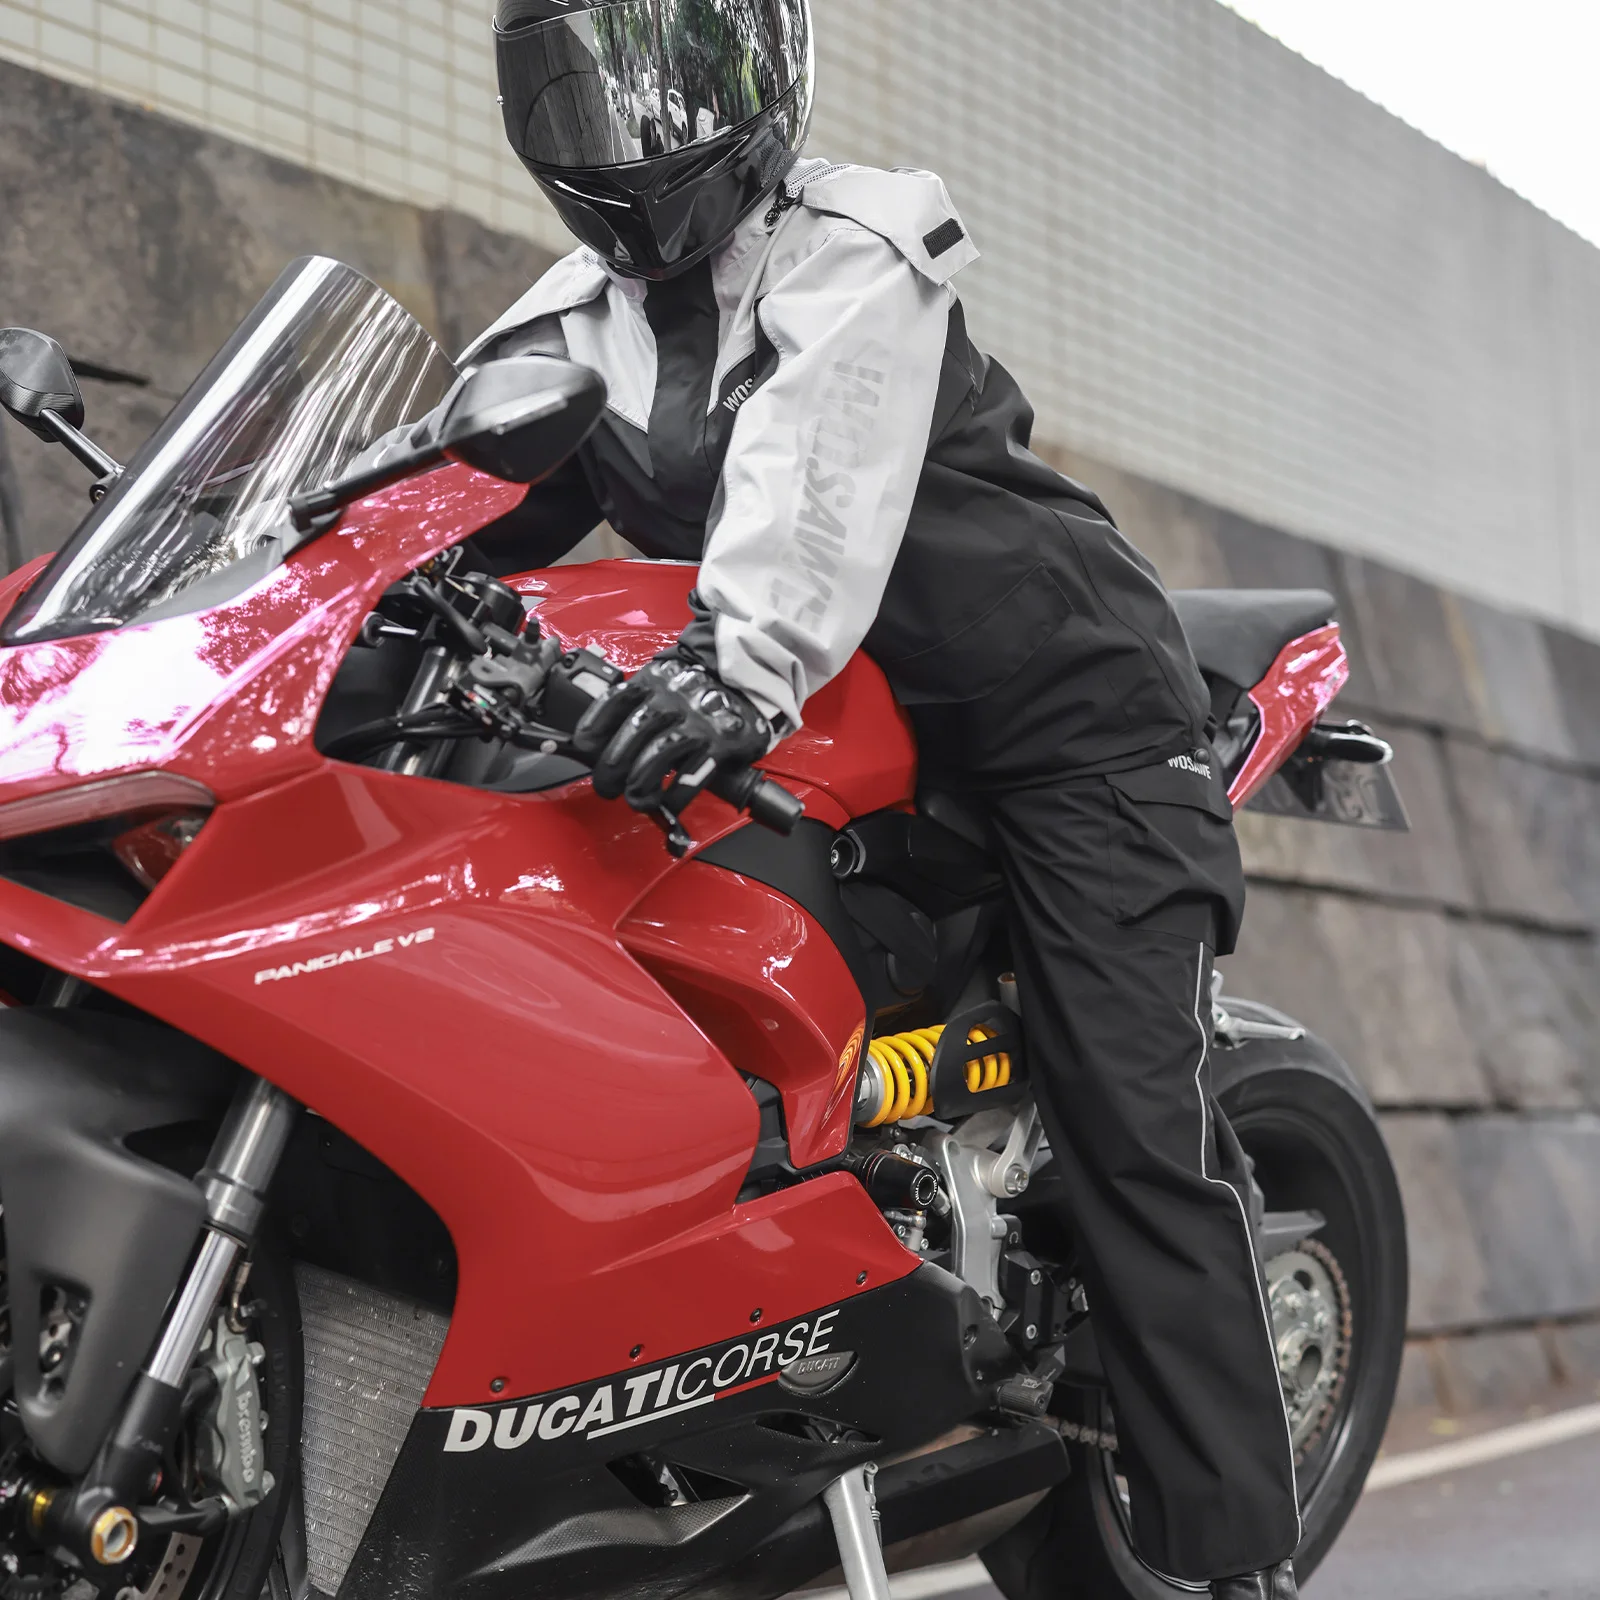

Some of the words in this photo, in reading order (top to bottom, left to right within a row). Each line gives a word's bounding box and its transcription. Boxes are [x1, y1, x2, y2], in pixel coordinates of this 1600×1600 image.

[722, 376, 755, 412] WOS
[397, 927, 435, 947] V2
[797, 1356, 841, 1375] DUCATI
[236, 1391, 257, 1483] brembo
